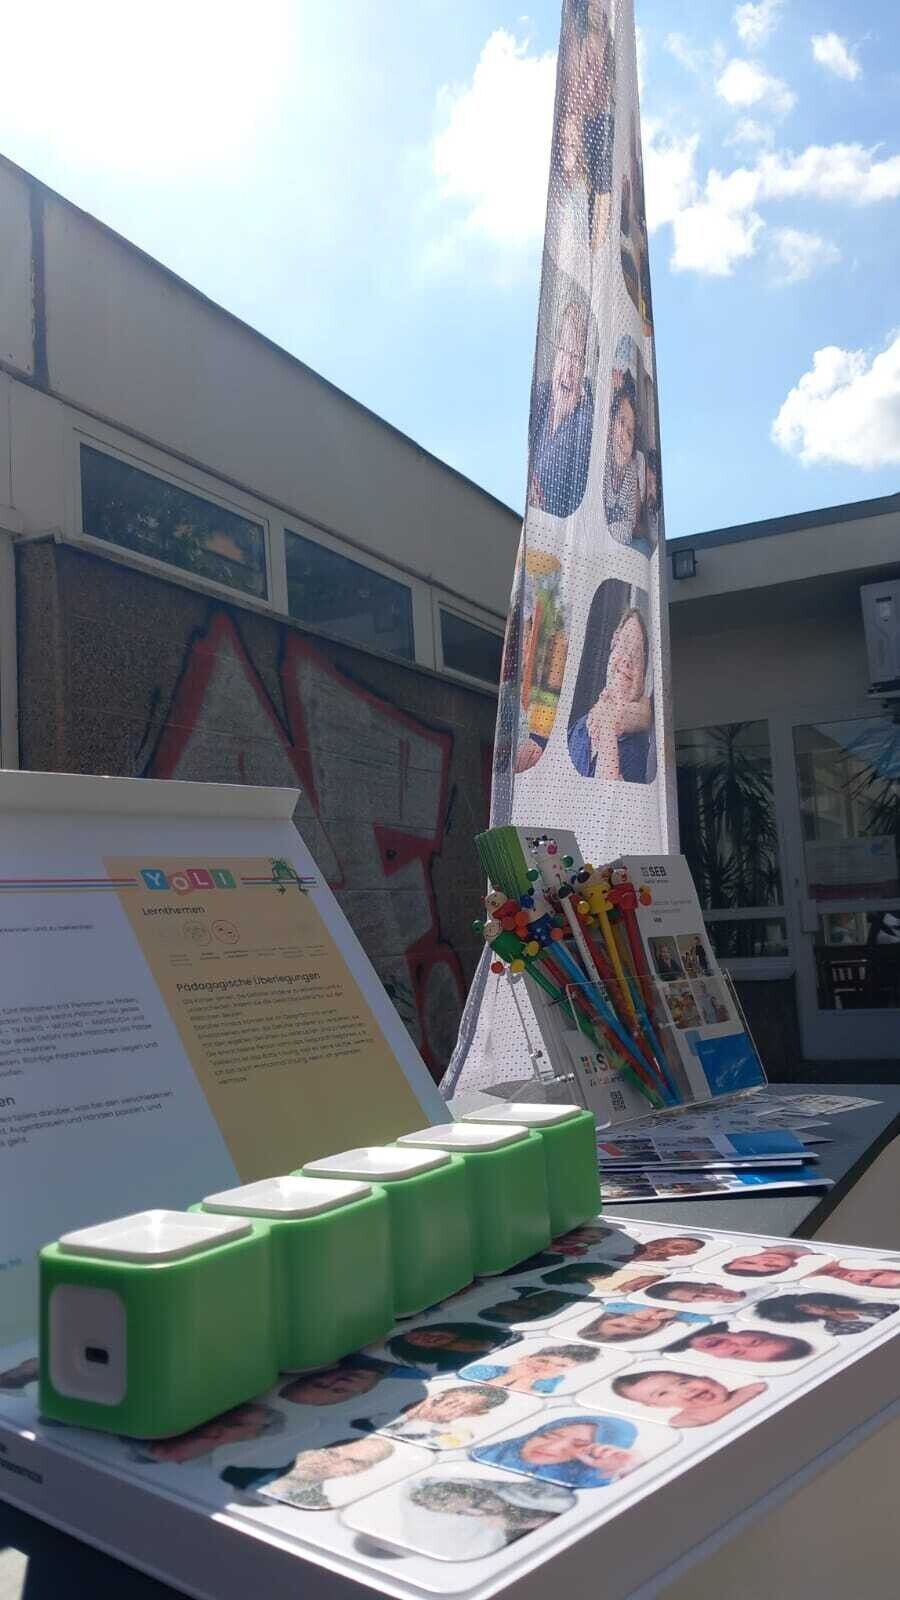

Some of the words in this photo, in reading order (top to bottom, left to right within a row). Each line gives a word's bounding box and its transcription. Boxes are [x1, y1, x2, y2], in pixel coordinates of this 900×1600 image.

[648, 866, 667, 877] SEB
[144, 869, 230, 891] YOLI
[142, 905, 205, 916] Lernthemen
[176, 978, 252, 993] Pädagogische
[254, 971, 321, 987] Überlegungen
